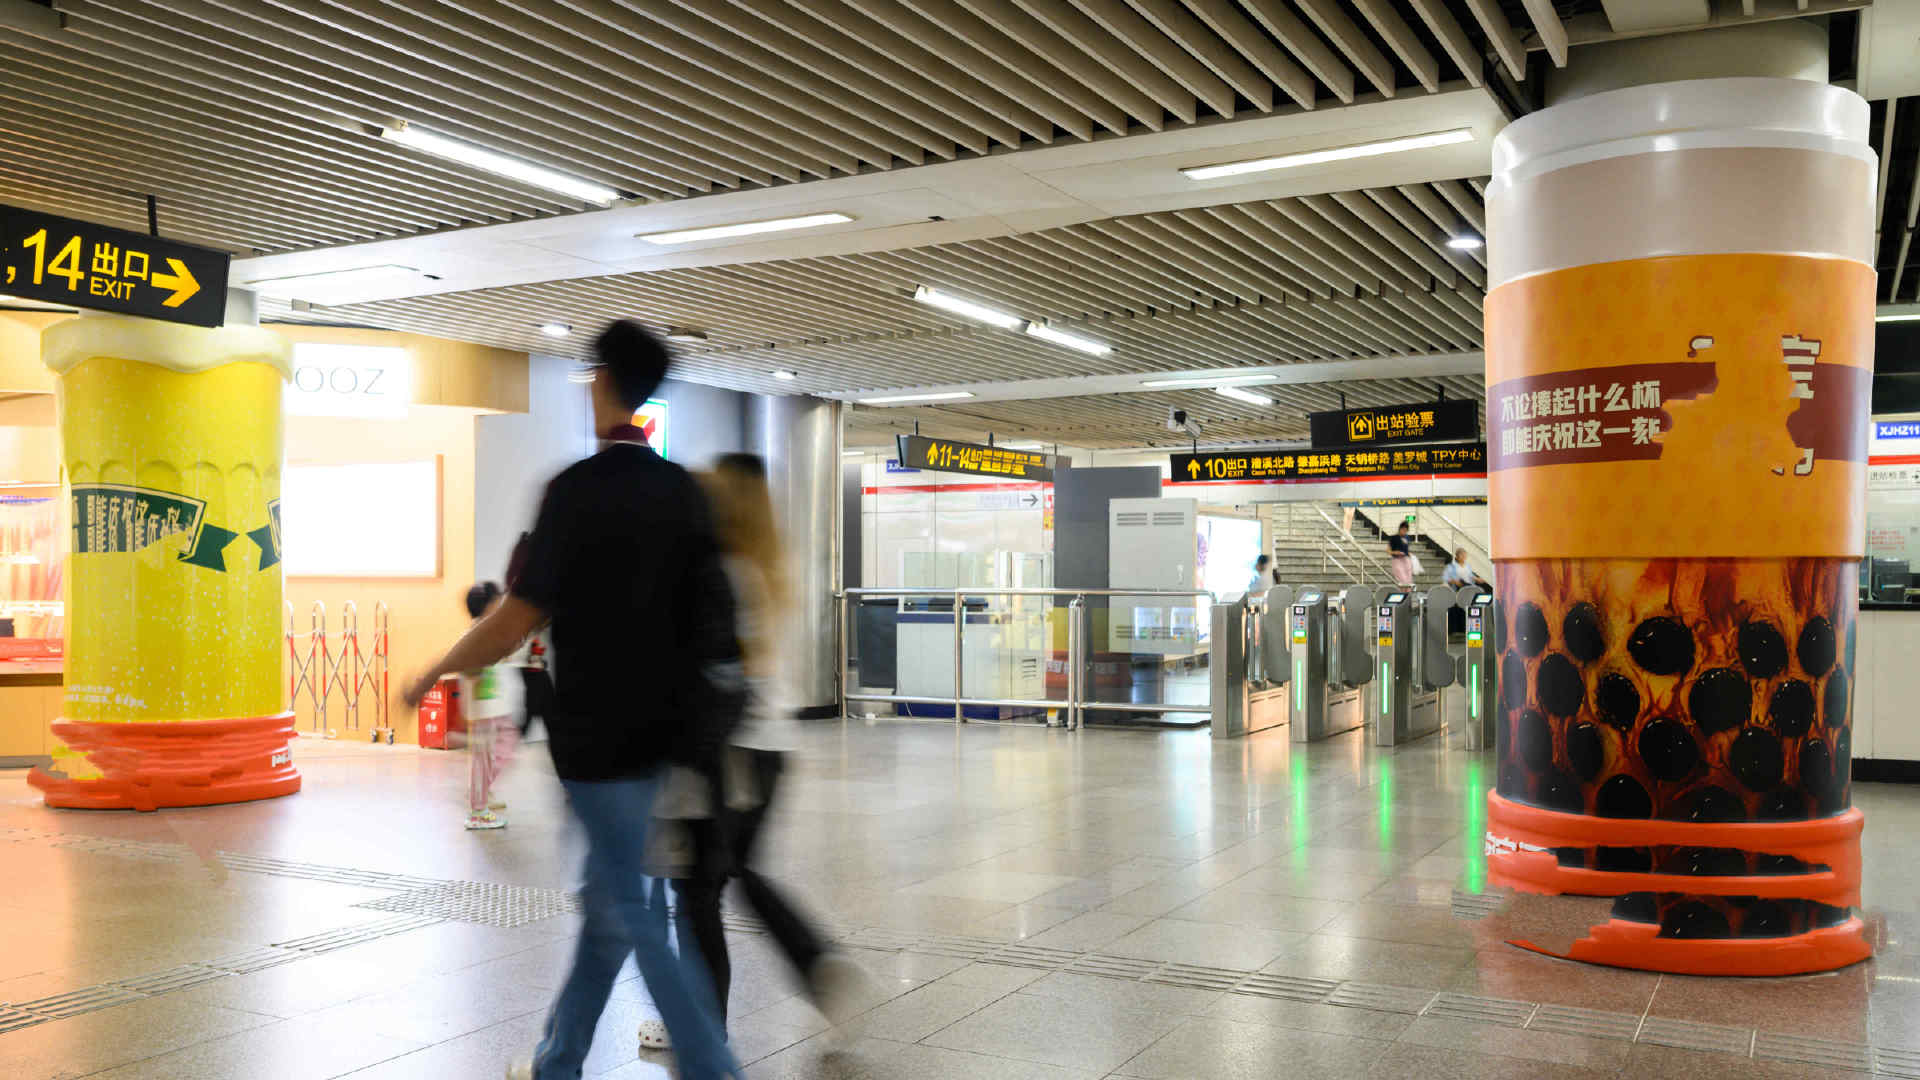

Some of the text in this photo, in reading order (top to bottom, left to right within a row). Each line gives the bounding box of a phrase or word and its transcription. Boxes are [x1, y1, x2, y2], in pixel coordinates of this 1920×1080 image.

[91, 242, 150, 281] 出口
[90, 276, 136, 301] EXIT
[1376, 411, 1435, 430] 出站验票
[1387, 429, 1402, 438] EXIT
[1204, 458, 1227, 478] 10
[1227, 458, 1248, 470] 出口
